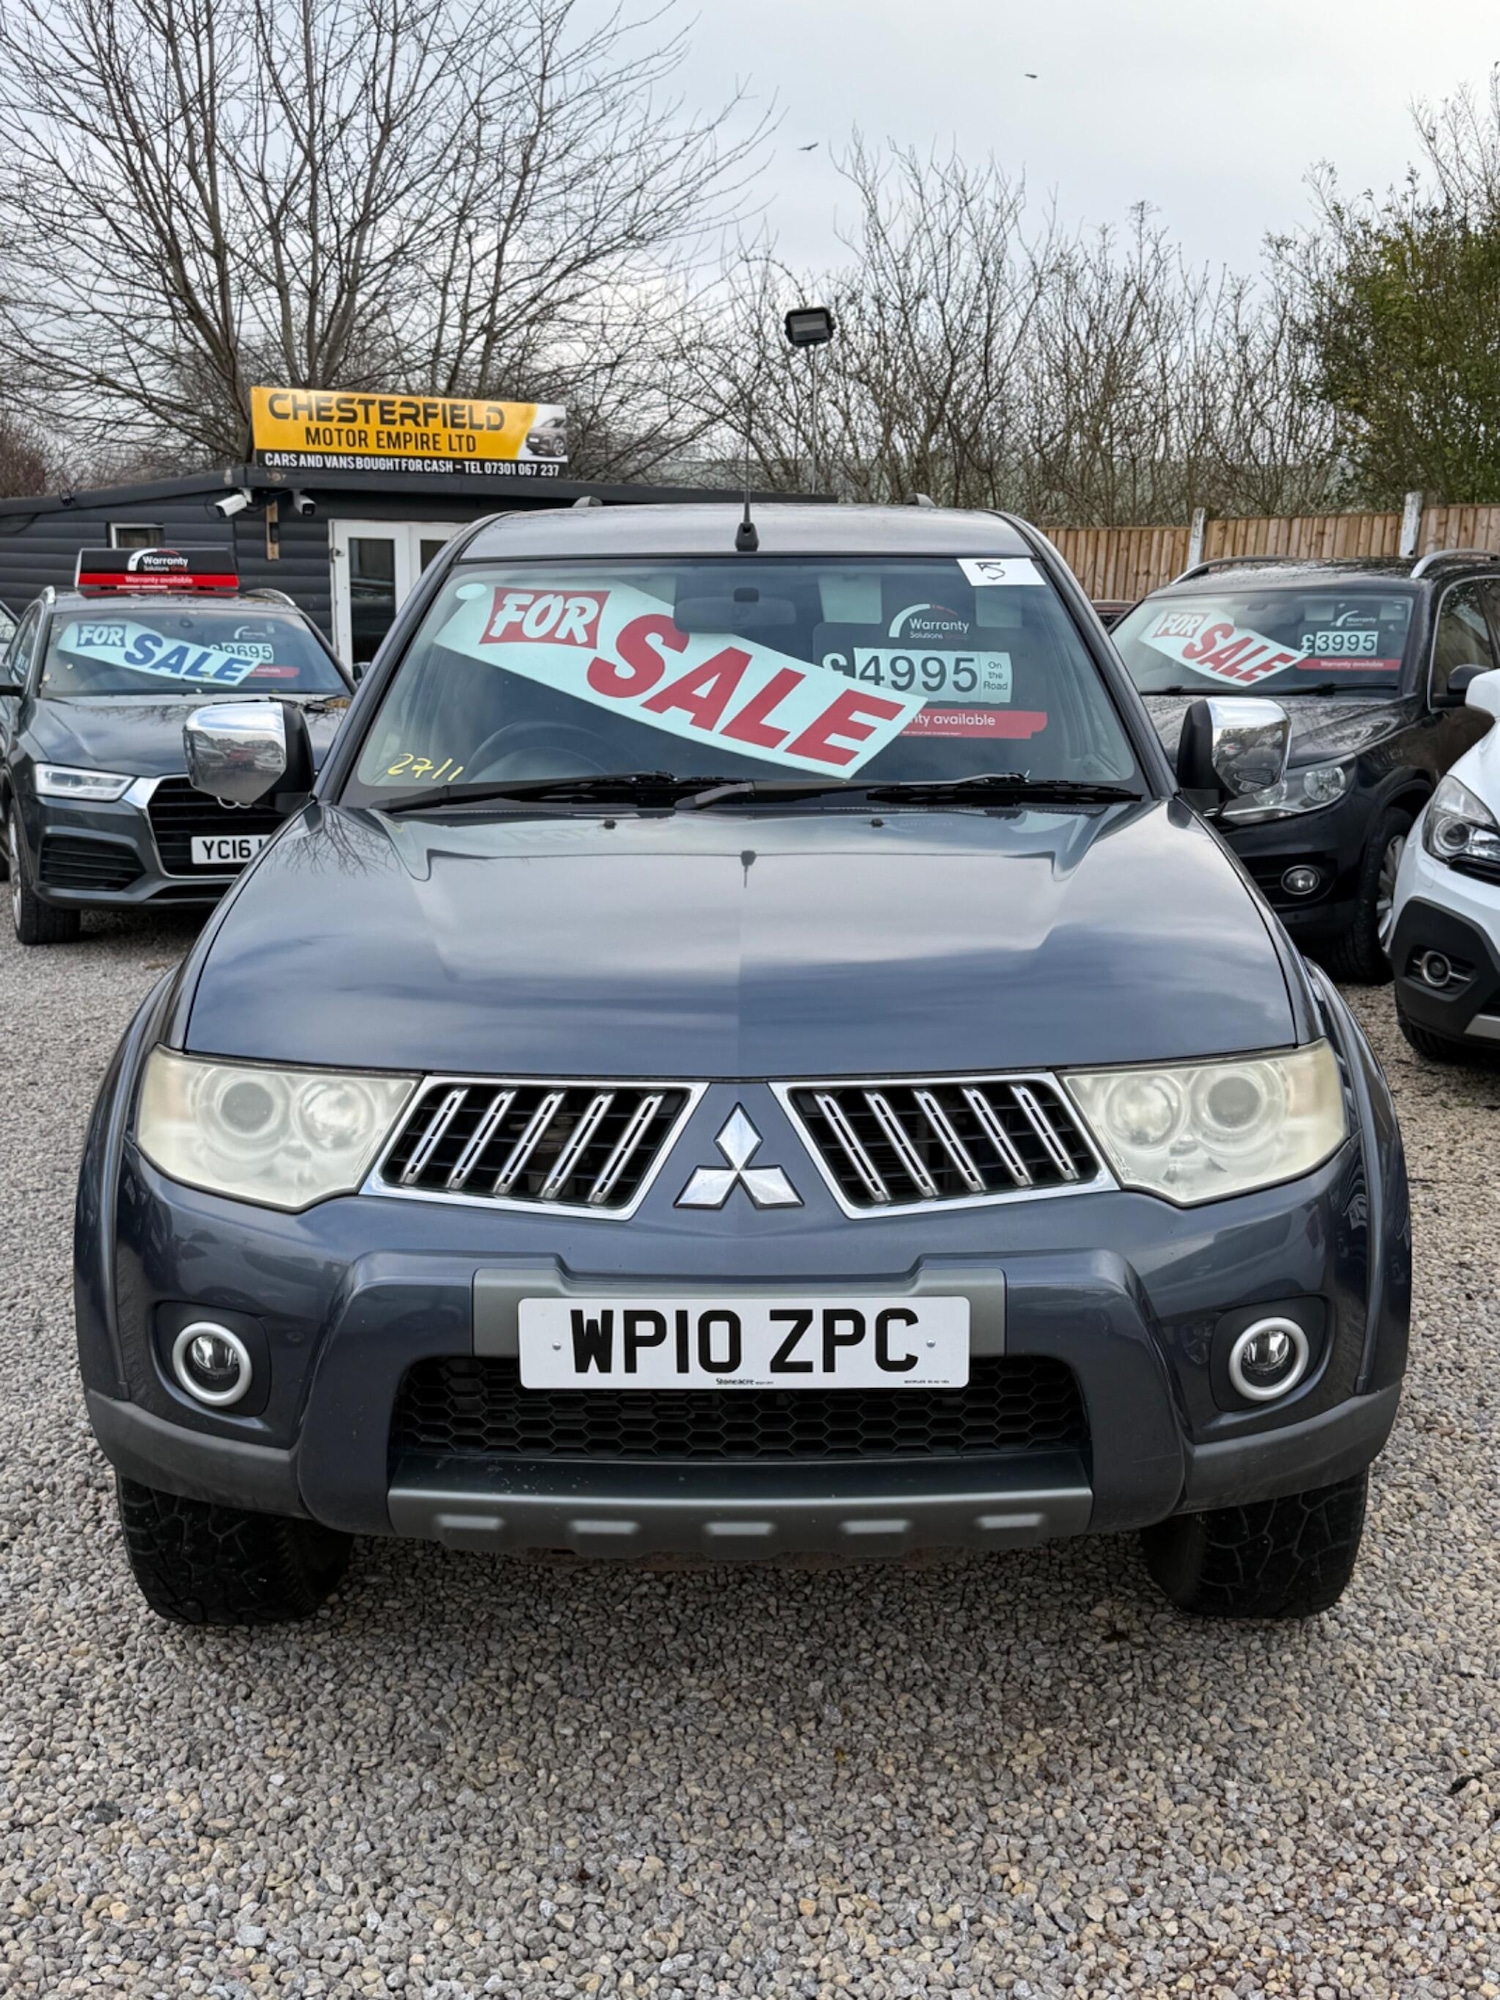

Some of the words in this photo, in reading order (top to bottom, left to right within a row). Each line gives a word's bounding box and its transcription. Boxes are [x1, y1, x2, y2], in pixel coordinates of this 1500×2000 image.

[268, 392, 505, 431] CHESTERFIELD
[305, 426, 369, 448] MOTOR
[376, 430, 442, 452] EMPIRE
[447, 433, 477, 453] LTD
[265, 452, 297, 467] CARS
[299, 453, 323, 468] AND
[324, 455, 355, 469] VANS
[356, 457, 400, 471] BOUGHT
[401, 459, 423, 471] FOR
[423, 459, 453, 472] CASH
[464, 461, 483, 474] TEL
[484, 462, 516, 475] 07301
[517, 464, 537, 476] 067
[540, 465, 559, 477] 237
[143, 556, 188, 567] Warranty
[125, 576, 158, 584] Warranty
[489, 592, 599, 645] FOR
[909, 618, 969, 632] Warranty
[1158, 613, 1202, 638] FOR
[78, 624, 125, 646] FOR
[910, 631, 943, 640] Solutions
[1301, 634, 1377, 653] £3995
[124, 633, 255, 682] SALE
[1182, 623, 1298, 683] SALE
[988, 661, 1002, 670] On
[988, 672, 1003, 680] the
[586, 612, 906, 767] SALE
[983, 681, 1008, 692] Road
[933, 714, 996, 726] available
[202, 838, 252, 860] YC16
[570, 1309, 742, 1374] WP10
[769, 1307, 920, 1373] ZPC
